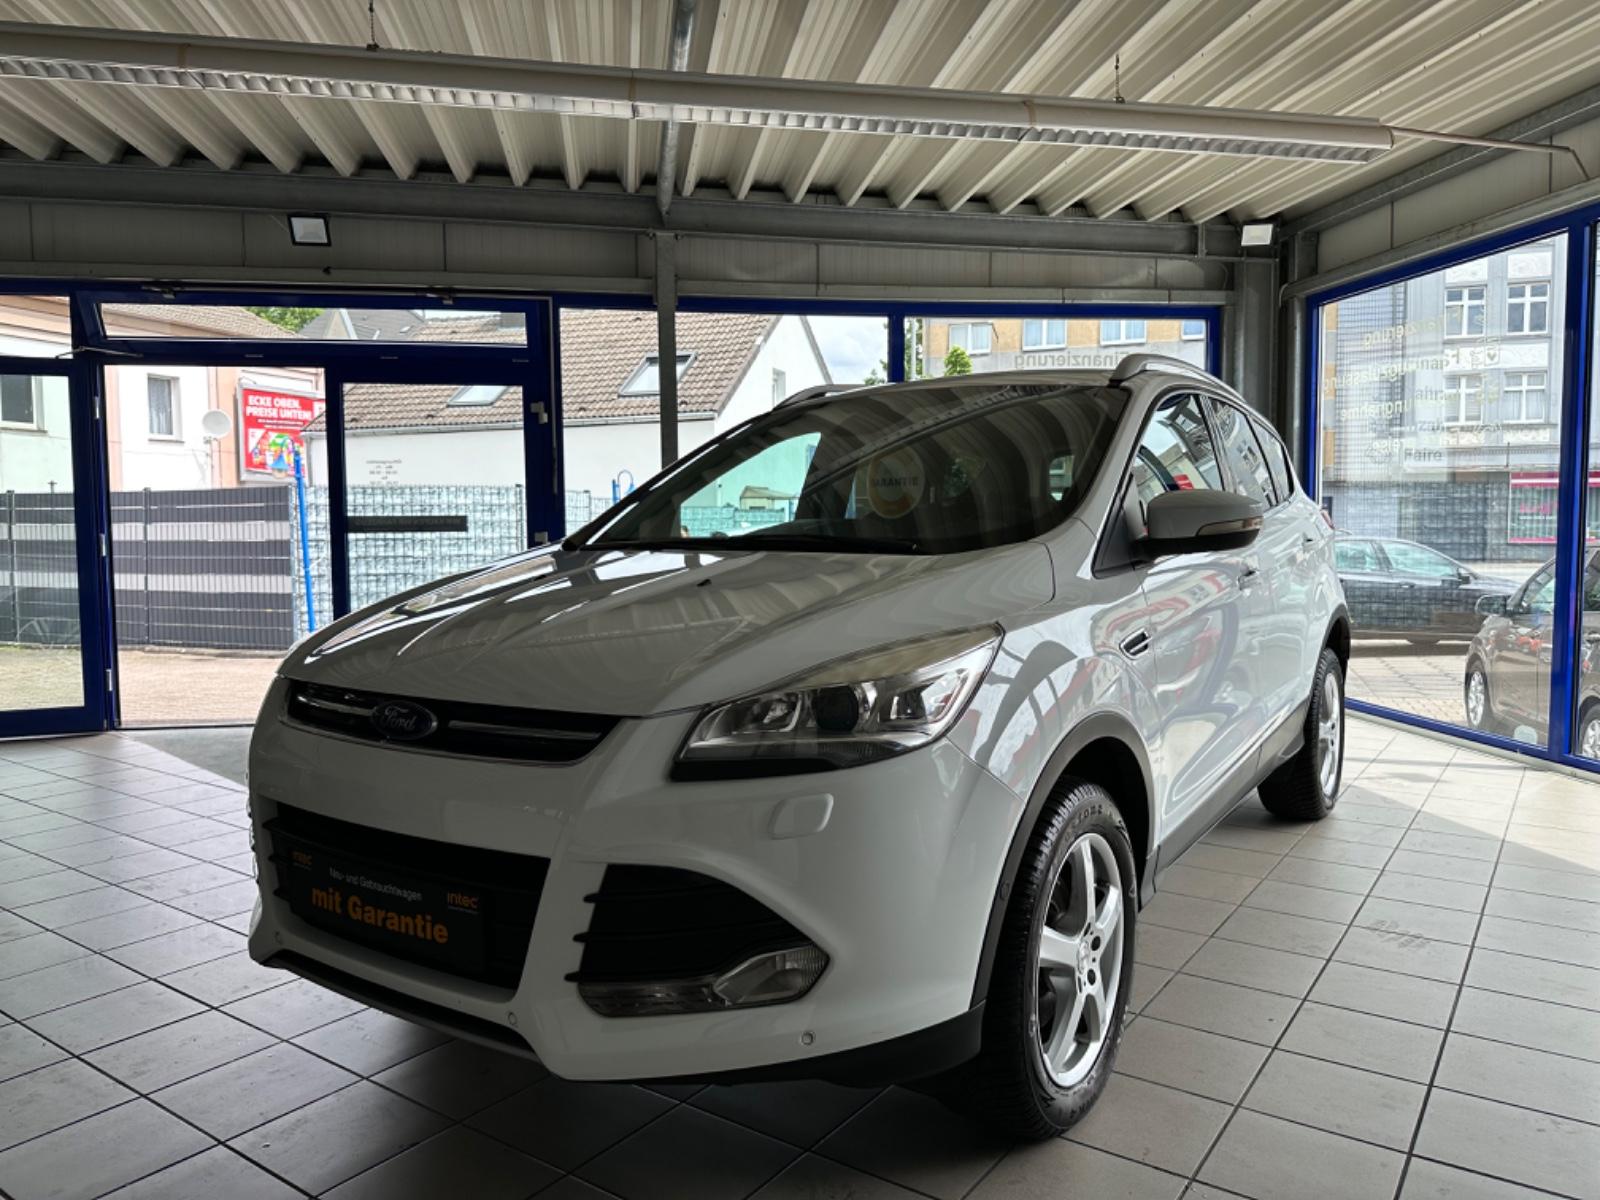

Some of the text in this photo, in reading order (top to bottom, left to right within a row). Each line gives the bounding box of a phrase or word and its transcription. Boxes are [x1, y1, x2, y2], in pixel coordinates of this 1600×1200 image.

[248, 395, 273, 407] ECKE
[246, 406, 279, 418] PREISE
[380, 704, 417, 731] Ford
[312, 886, 449, 944] mit Garantie
